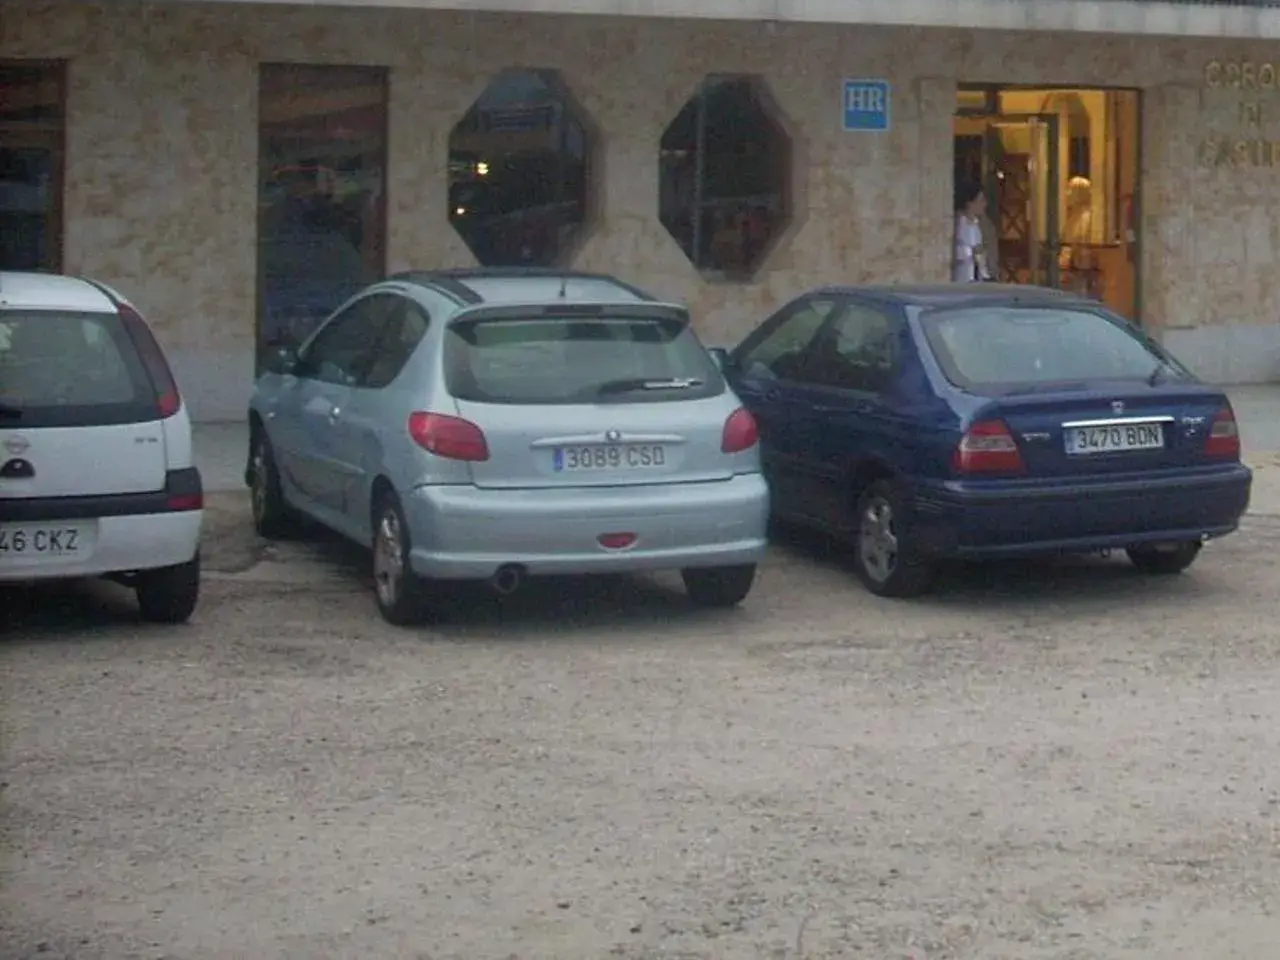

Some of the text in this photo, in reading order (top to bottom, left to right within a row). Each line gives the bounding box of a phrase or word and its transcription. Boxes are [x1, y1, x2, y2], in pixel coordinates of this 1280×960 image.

[1078, 428, 1121, 449] 3470
[567, 447, 621, 468] 3089
[33, 528, 79, 551] CKZ
